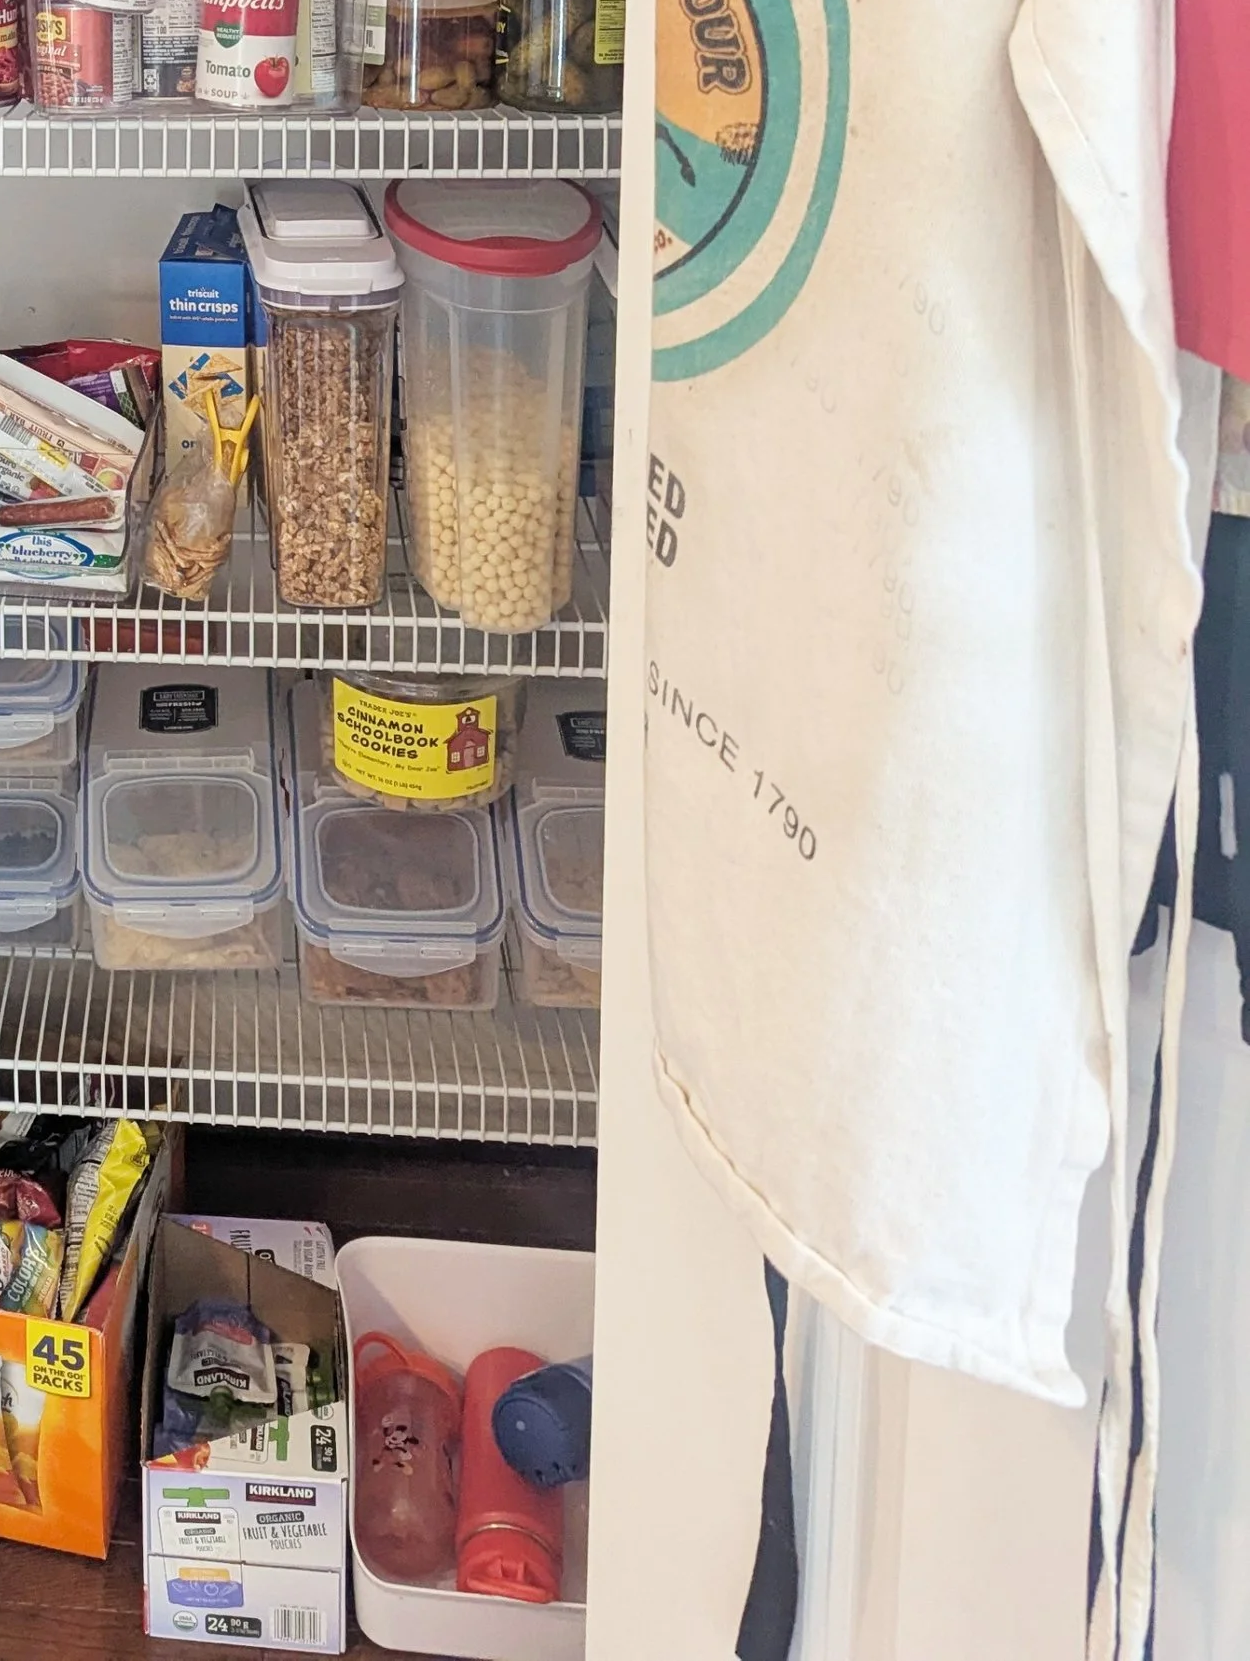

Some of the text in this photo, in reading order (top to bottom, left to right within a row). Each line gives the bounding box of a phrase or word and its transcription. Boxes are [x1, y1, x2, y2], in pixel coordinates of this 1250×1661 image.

[216, 26, 240, 34] HEALTHY
[205, 59, 252, 78] Tomato
[211, 89, 238, 100] SOUP
[187, 287, 220, 299] triscuit
[169, 298, 239, 315] thin crisps
[9, 411, 54, 442] FRUIT BAR
[31, 535, 52, 547] this
[11, 544, 73, 561] blueberry
[359, 699, 412, 719] TRADER JOE'S
[347, 705, 424, 735] CINNAMON
[336, 711, 440, 748] SCHOOLBOOK
[350, 733, 419, 760] COOKIES
[407, 765, 424, 773] Dear
[647, 659, 817, 862] SINCE 1790
[32, 1335, 85, 1371] 45
[33, 1365, 85, 1380] ON THE GO!
[195, 1372, 248, 1389] KIRKLAND
[33, 1372, 83, 1393] PACKS
[316, 1427, 333, 1445] 24
[249, 1484, 314, 1499] KIRKLAND
[177, 1512, 220, 1521] KIRKLAND
[258, 1513, 303, 1524] ORGANIC
[178, 1536, 193, 1545] FRUIT
[200, 1535, 227, 1545] VEGETABLE
[184, 1528, 215, 1536] ORGANIC
[242, 1523, 328, 1540] FRUIT & VEGETABLE
[270, 1539, 303, 1550] POUCHES
[207, 1617, 229, 1633] 24
[230, 1618, 242, 1627] 90
